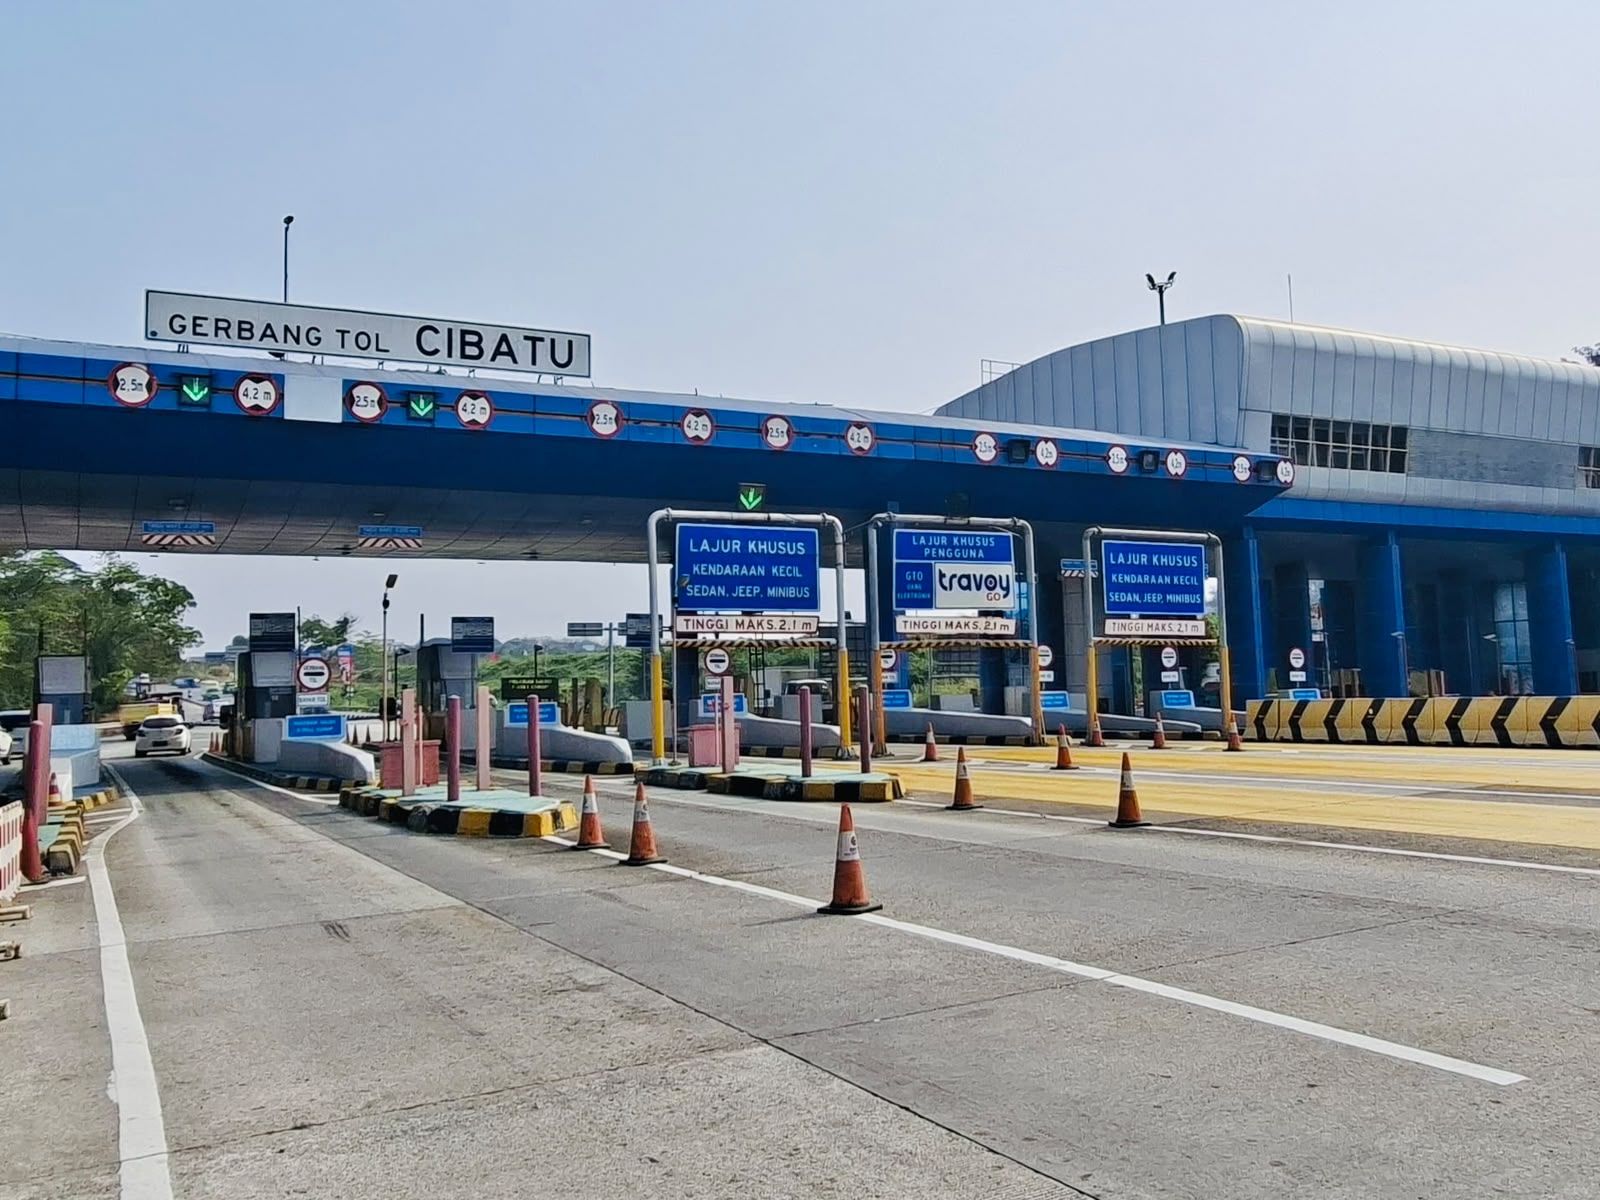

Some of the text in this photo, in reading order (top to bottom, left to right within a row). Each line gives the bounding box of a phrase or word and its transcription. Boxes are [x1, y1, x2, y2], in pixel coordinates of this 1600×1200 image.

[168, 314, 574, 369] GERBANG TOL CIBATU
[689, 538, 805, 555] LAJUR KHUSUS
[912, 535, 995, 547] LAJUR KHUSUS
[924, 548, 984, 558] PENGGUNA
[1110, 552, 1148, 565] LAJUR
[1152, 554, 1198, 567] KHUSUS
[693, 564, 802, 577] KENDARAAN KECIL
[938, 568, 1010, 599] travoy
[1111, 573, 1198, 586] KENDARAAN KECIL
[767, 586, 810, 598] MINIBUS
[986, 592, 1001, 602] GO
[1166, 593, 1201, 604] MINIBUS
[684, 618, 729, 630] TINGGI
[902, 620, 941, 630] TINGGI
[1112, 622, 1144, 632] TINGGI
